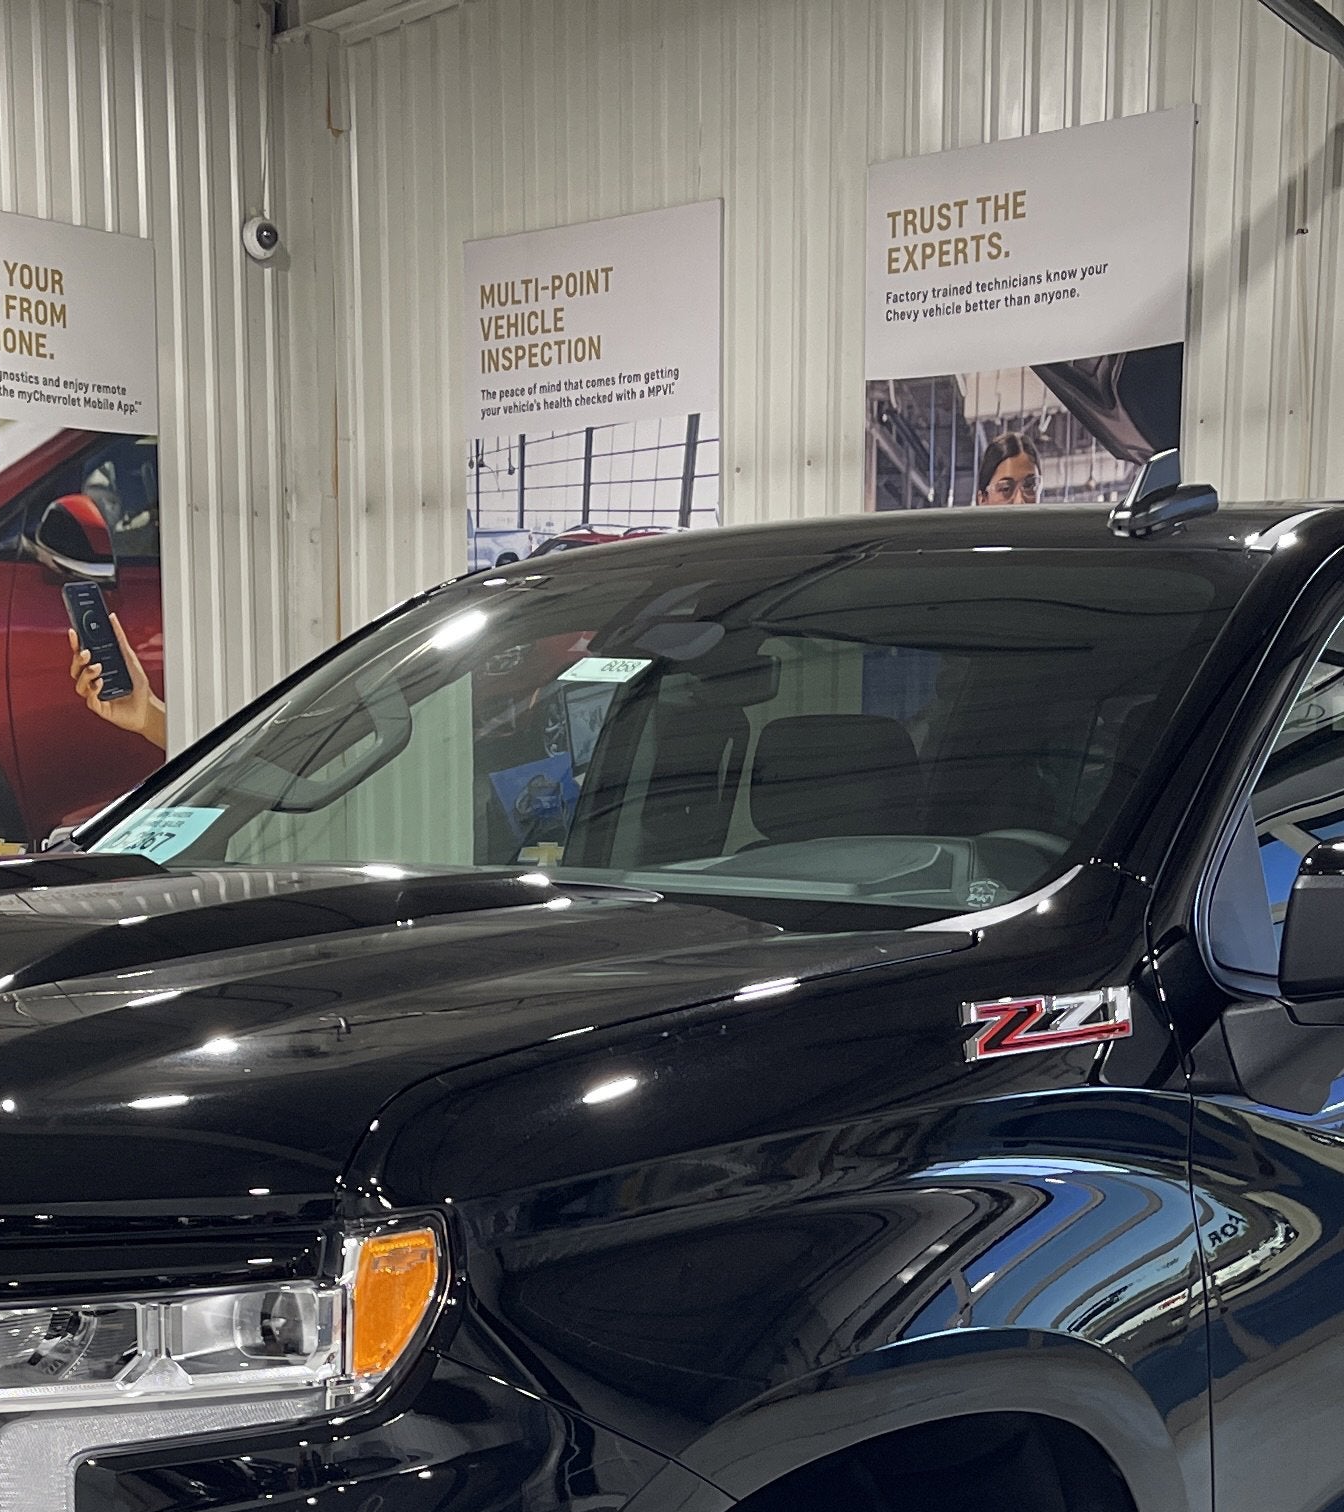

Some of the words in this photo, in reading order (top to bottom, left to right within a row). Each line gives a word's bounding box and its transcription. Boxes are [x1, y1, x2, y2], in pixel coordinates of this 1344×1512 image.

[887, 199, 968, 239] TRUST
[976, 189, 1027, 225] THE
[887, 231, 1010, 275] EXPERTS.
[4, 259, 64, 295] YOUR
[480, 266, 613, 309] MULTI-POINT
[886, 289, 928, 304] Factory
[931, 281, 973, 298] trained
[975, 272, 1043, 293] technicians
[1045, 268, 1077, 283] know
[1080, 262, 1108, 281] your
[5, 293, 67, 329] FROM
[886, 308, 919, 323] Chevy
[922, 301, 961, 319] vehicle
[965, 298, 1001, 313] better
[1004, 293, 1031, 309] than
[1033, 287, 1080, 305] anyone.
[480, 307, 565, 342] VEHICLE
[481, 335, 601, 374] INSPECTION
[18, 389, 81, 408] myChevrolet
[83, 396, 115, 411] Mobile
[42, 376, 60, 388] and
[63, 378, 89, 395] enjoy
[91, 383, 127, 396] remote
[481, 389, 497, 401] The
[499, 387, 525, 402] peace
[527, 383, 537, 396] of
[539, 380, 561, 394] mind
[564, 377, 583, 391] that
[585, 375, 615, 388] comes
[618, 371, 641, 385] from
[644, 366, 679, 384] getting
[480, 405, 501, 420] your
[503, 399, 541, 415] vehicle's
[543, 395, 572, 411] health
[574, 391, 613, 407] checked
[615, 387, 636, 401] with
[639, 389, 645, 399] a
[958, 985, 1133, 1062] Z71
